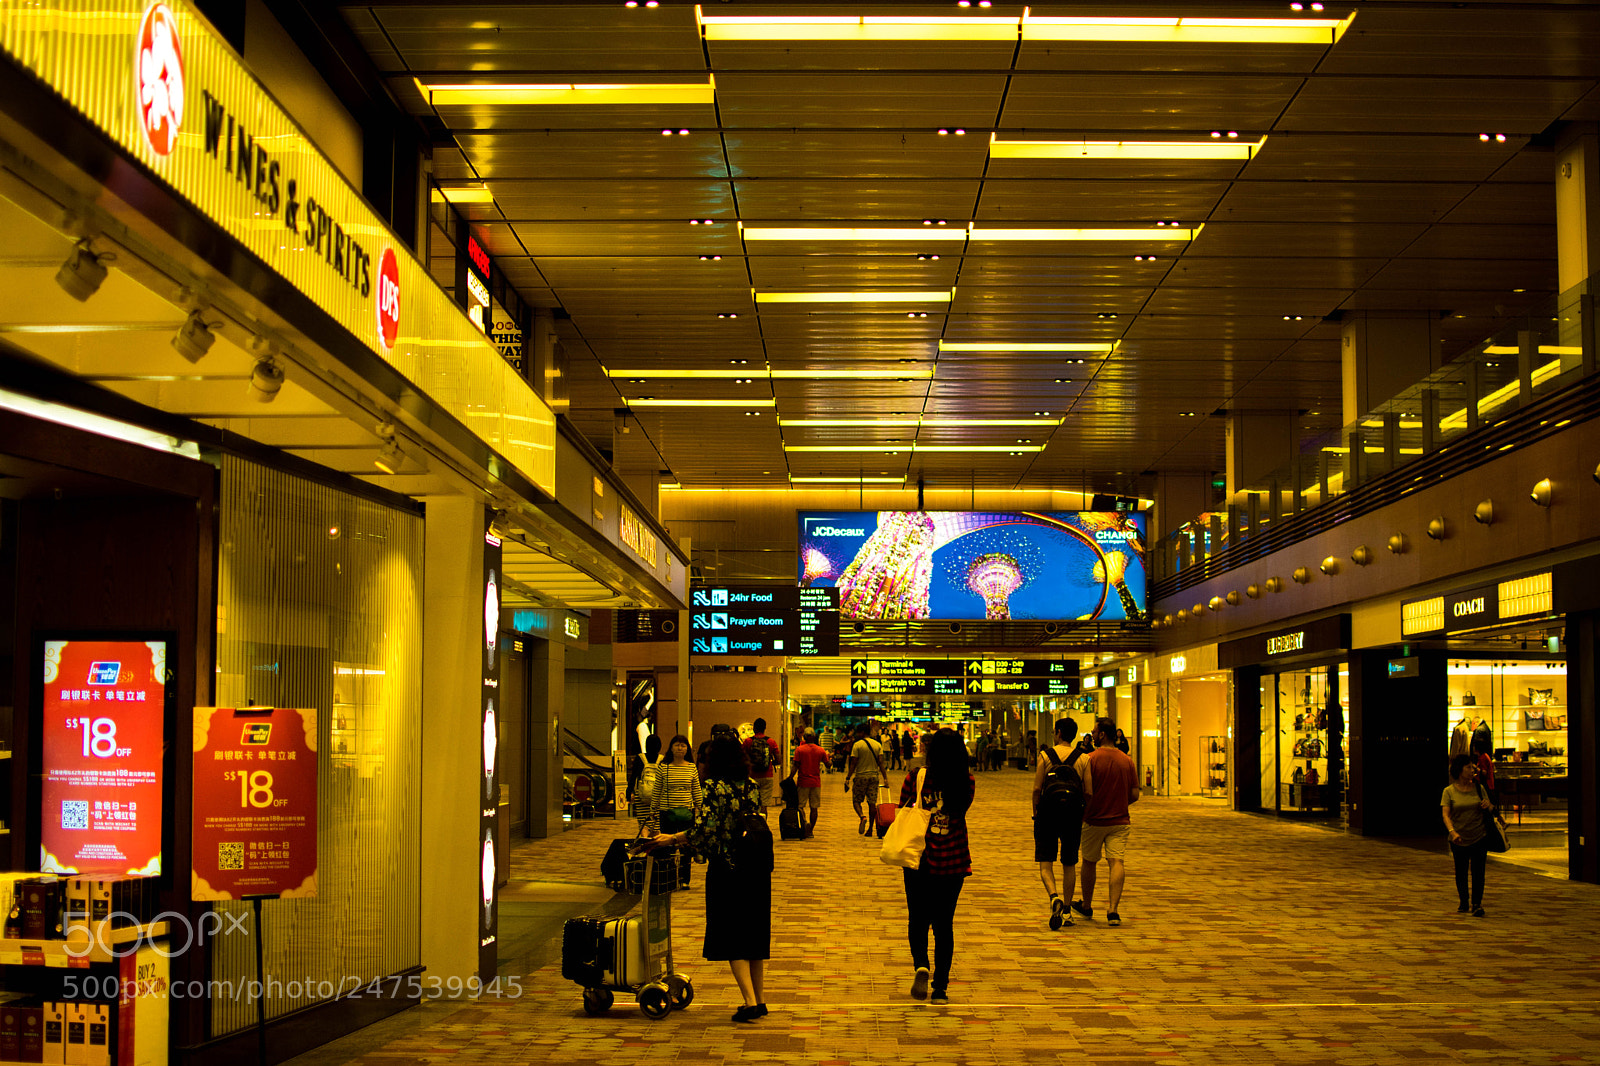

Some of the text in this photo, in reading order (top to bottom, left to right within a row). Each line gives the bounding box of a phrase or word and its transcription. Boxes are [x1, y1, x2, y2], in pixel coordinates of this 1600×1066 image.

[203, 89, 280, 213] WINES
[285, 178, 299, 235] &
[305, 196, 370, 298] SPIRITS
[381, 273, 399, 322] DFS
[812, 526, 865, 536] JCDecaux
[1096, 531, 1137, 540] CHANGI
[730, 593, 772, 602] 24hr Food
[1454, 597, 1485, 617] COACH
[730, 617, 783, 627] Prayer Room
[730, 641, 762, 650] Lounge
[881, 679, 907, 687] Skytrain
[80, 717, 116, 757] 18
[237, 770, 274, 808] 18
[273, 799, 288, 807] OFF
[138, 963, 155, 980] BUY 2
